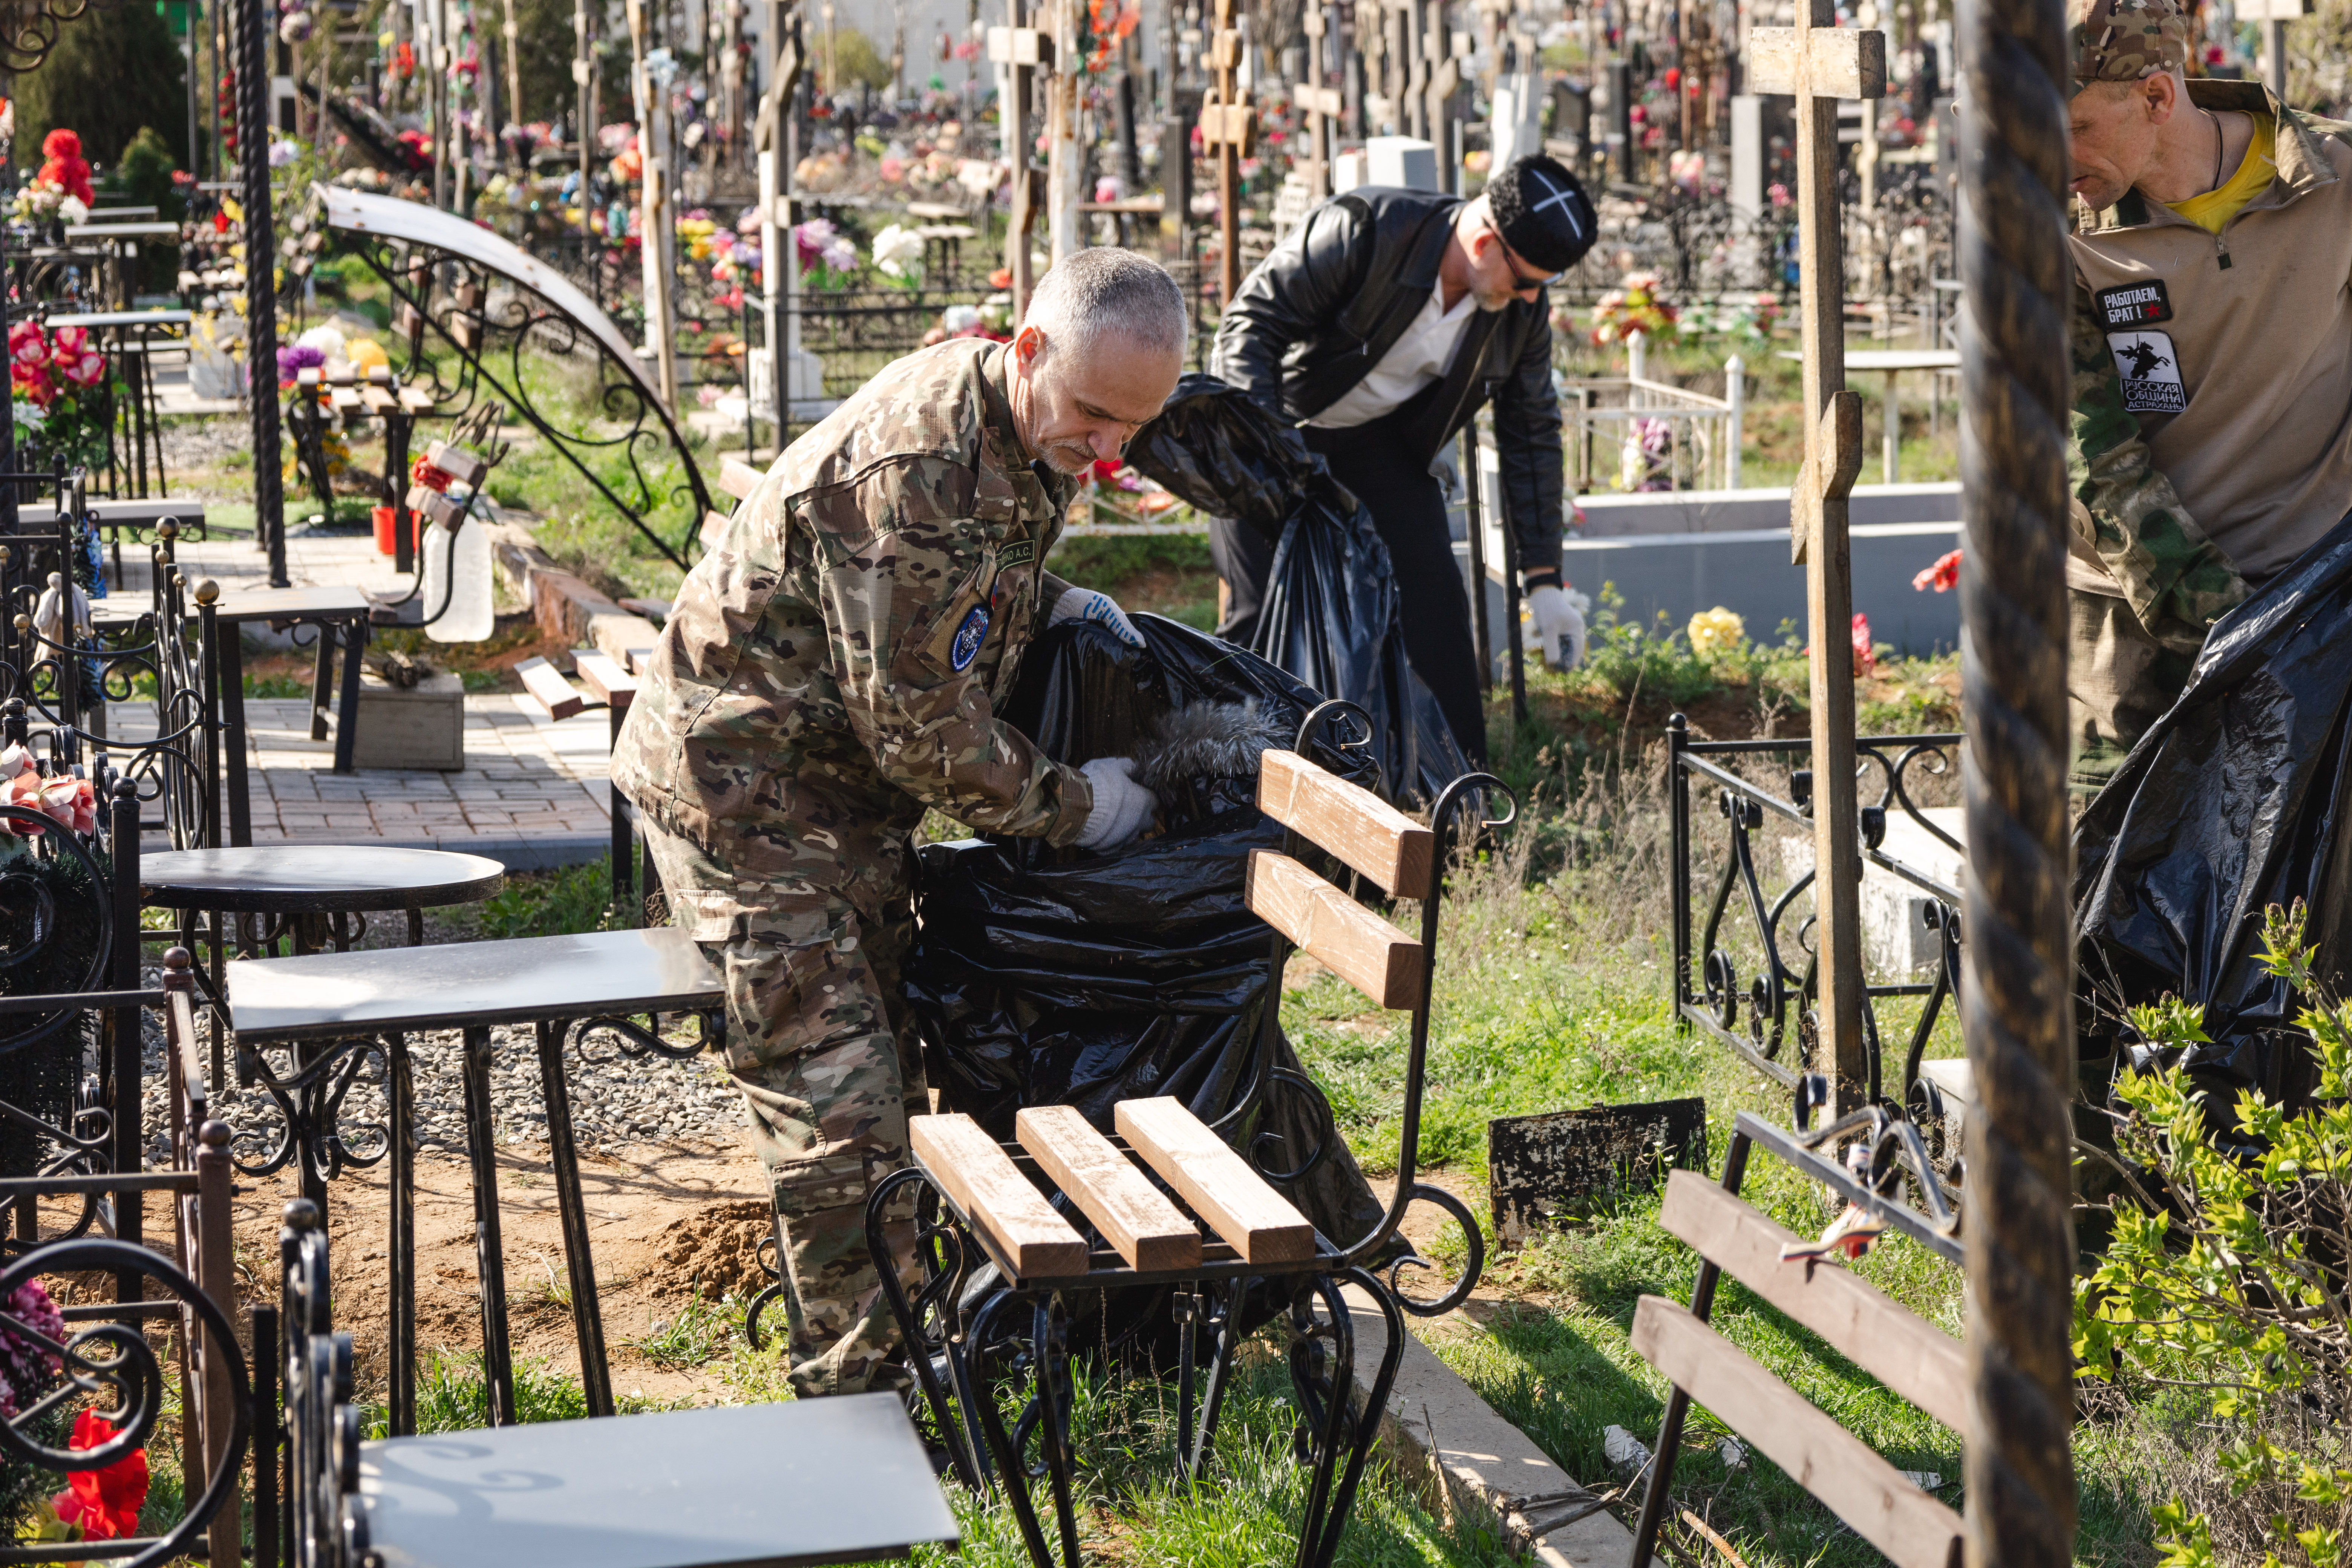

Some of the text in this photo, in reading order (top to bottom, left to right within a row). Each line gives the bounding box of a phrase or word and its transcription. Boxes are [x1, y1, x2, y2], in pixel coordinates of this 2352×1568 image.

[2104, 287, 2161, 309] РАБОТАЕМ,
[2107, 306, 2134, 323] БРАТ
[2124, 380, 2179, 393] РУССКАЯ
[2126, 390, 2181, 403] ОБЩИНА
[2128, 401, 2182, 410] АСТРАХАНЬ
[1016, 547, 1031, 559] А.С.
